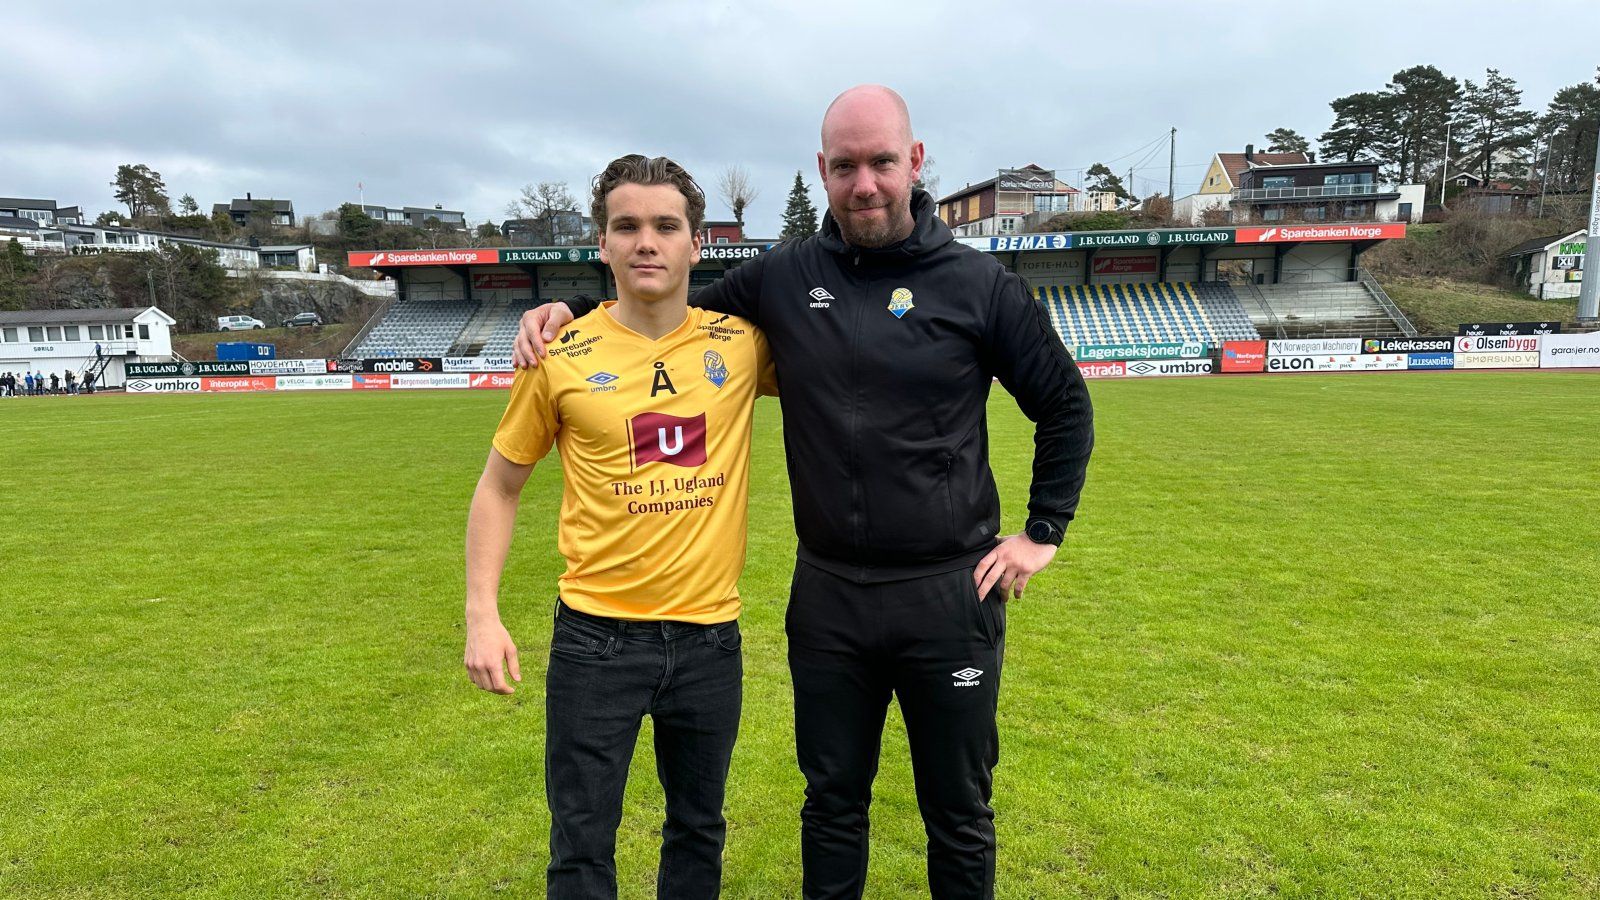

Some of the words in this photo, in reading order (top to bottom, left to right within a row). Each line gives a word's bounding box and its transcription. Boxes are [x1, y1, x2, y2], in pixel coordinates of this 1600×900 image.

[1280, 229, 1348, 239] Sparebanken
[1350, 227, 1382, 237] Norge
[996, 236, 1047, 250] BEMA
[388, 254, 448, 264] Sparebanken
[449, 252, 477, 262] Norge
[699, 247, 759, 258] ekassen
[708, 331, 732, 342] Norge
[548, 335, 603, 357] Sparebanken
[1284, 342, 1320, 352] Norwegian
[1322, 340, 1359, 351] Machinery
[1381, 340, 1451, 351] Lekekassen
[1476, 337, 1537, 351] Olsenbygg
[566, 346, 593, 358] Norge
[1081, 345, 1200, 359] Lagerseksjoner.no
[1551, 346, 1600, 355] garasjer.no
[250, 360, 305, 369] HOVDEHYTTA
[374, 360, 414, 372] mobile
[444, 358, 473, 366] Agder
[1160, 361, 1212, 374] umbro
[650, 361, 678, 397] Å
[154, 380, 200, 391] umbro
[590, 385, 617, 393] umbro
[658, 425, 684, 456] U
[612, 480, 643, 496] The
[649, 479, 670, 496] J.J.
[674, 472, 725, 493] Ugland
[627, 495, 714, 515] Companies
